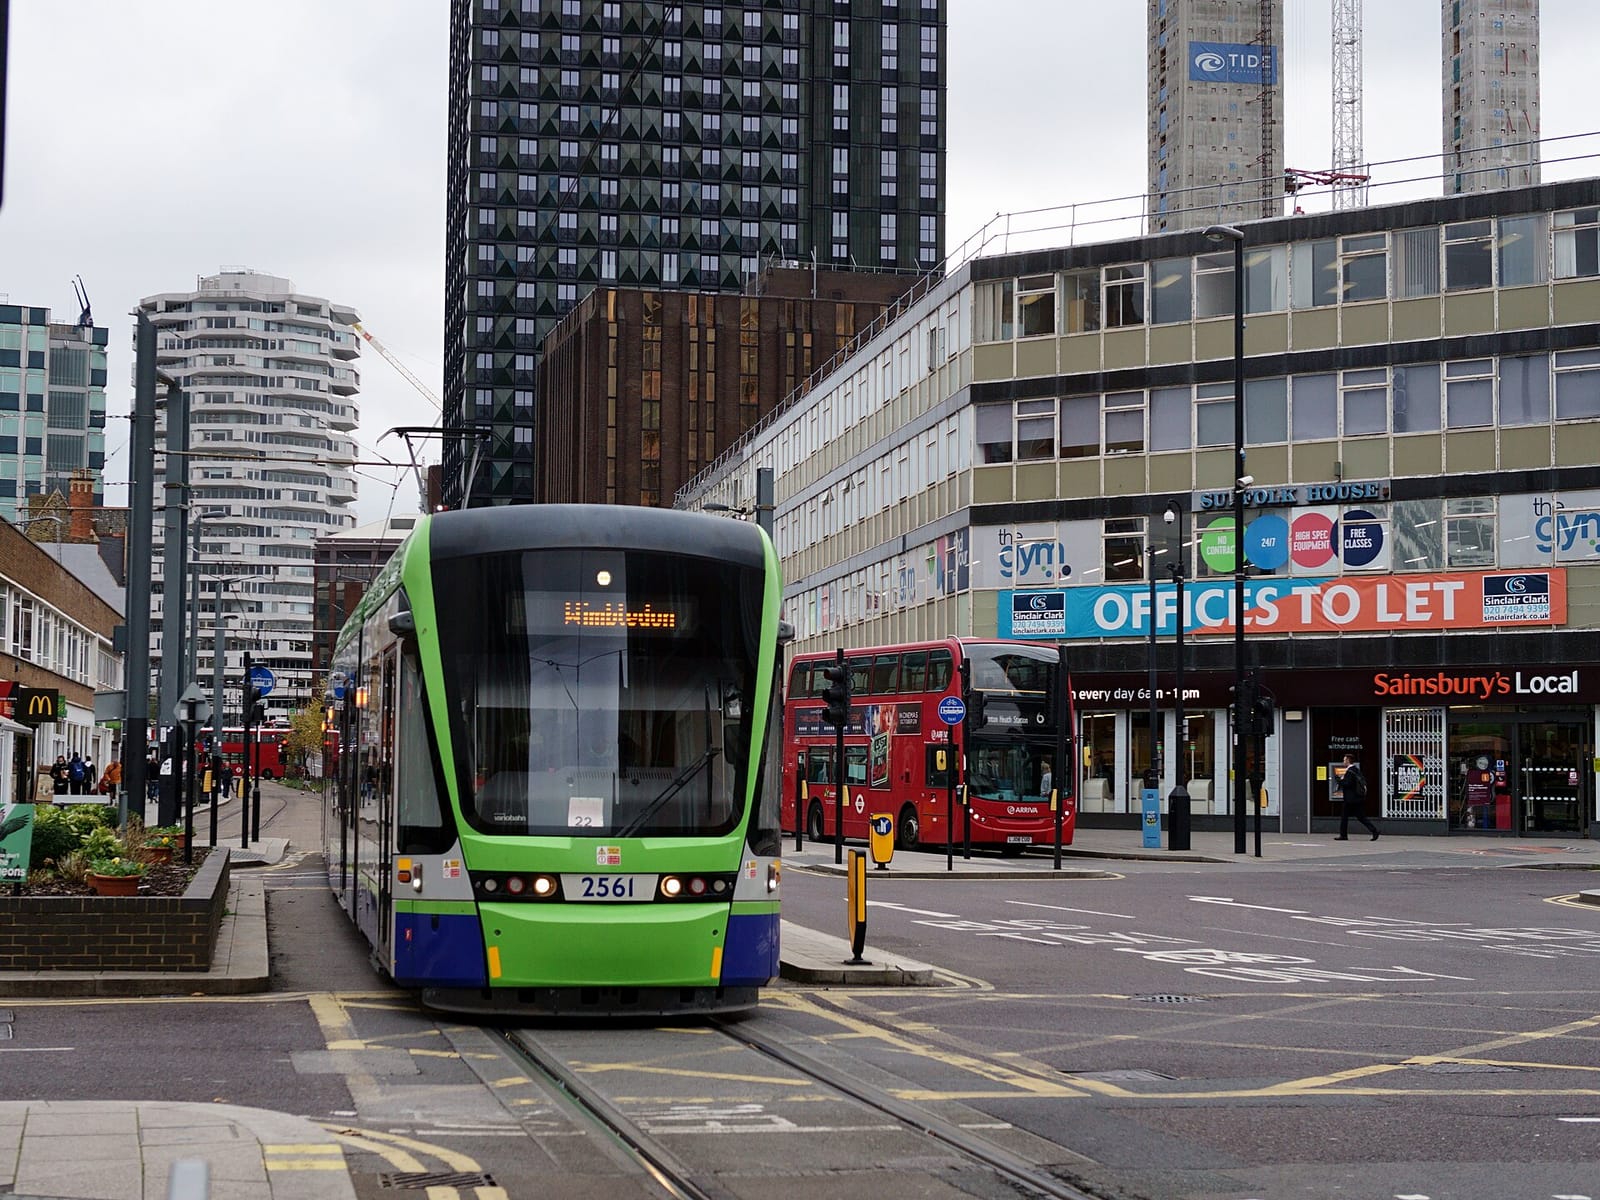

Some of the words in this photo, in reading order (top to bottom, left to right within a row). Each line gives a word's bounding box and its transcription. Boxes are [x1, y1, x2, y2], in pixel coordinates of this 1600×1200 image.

[1306, 481, 1380, 502] HOUSE
[1295, 530, 1311, 541] HIGH
[1312, 529, 1329, 540] SPEC
[1350, 528, 1367, 538] FREE
[1261, 537, 1276, 548] 24/7
[1293, 539, 1331, 552] EQUIPMENT
[1344, 538, 1373, 549] CLASSES
[1206, 544, 1236, 555] CONTRAC
[999, 542, 1065, 578] gym
[1485, 596, 1520, 605] Sinclair
[1523, 594, 1548, 604] Clark
[1094, 586, 1280, 631] OFFICES
[1292, 584, 1361, 624] TO
[1376, 581, 1465, 622] LET
[1484, 605, 1501, 614] 020
[1502, 605, 1524, 613] 7494
[1526, 604, 1549, 613] 9399
[565, 601, 675, 627] Wimbledon
[1014, 612, 1042, 620] Sinclair
[1043, 611, 1064, 619] Clark
[1484, 612, 1549, 621] sinclairclark.co.uk
[1374, 671, 1510, 699] Sainsbury's
[1515, 670, 1579, 693] Local
[1078, 689, 1111, 702] every
[1114, 688, 1134, 702] day
[1036, 712, 1045, 724] 6
[494, 813, 527, 822] variobahn
[0, 867, 26, 877] eons
[581, 876, 634, 898] 2561
[1184, 965, 1476, 984] ONLY
